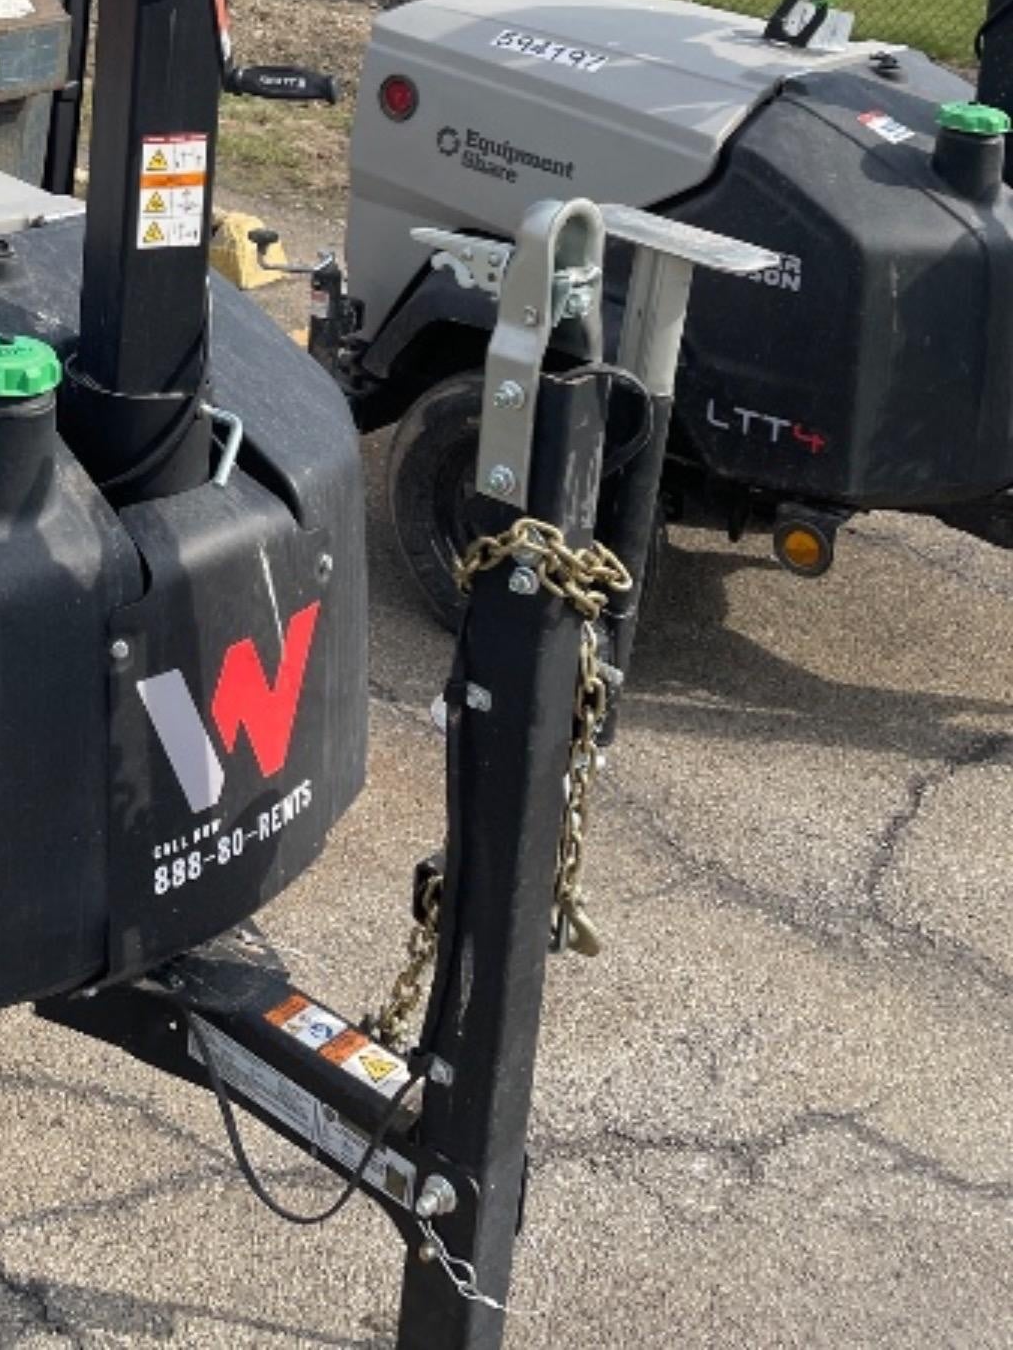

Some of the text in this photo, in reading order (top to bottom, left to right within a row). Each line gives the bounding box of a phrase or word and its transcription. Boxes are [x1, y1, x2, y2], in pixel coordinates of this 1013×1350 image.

[461, 149, 519, 184] Share
[465, 128, 574, 180] Equipment
[707, 398, 826, 454] LTT4
[154, 778, 313, 896] 888-80-RENTS
